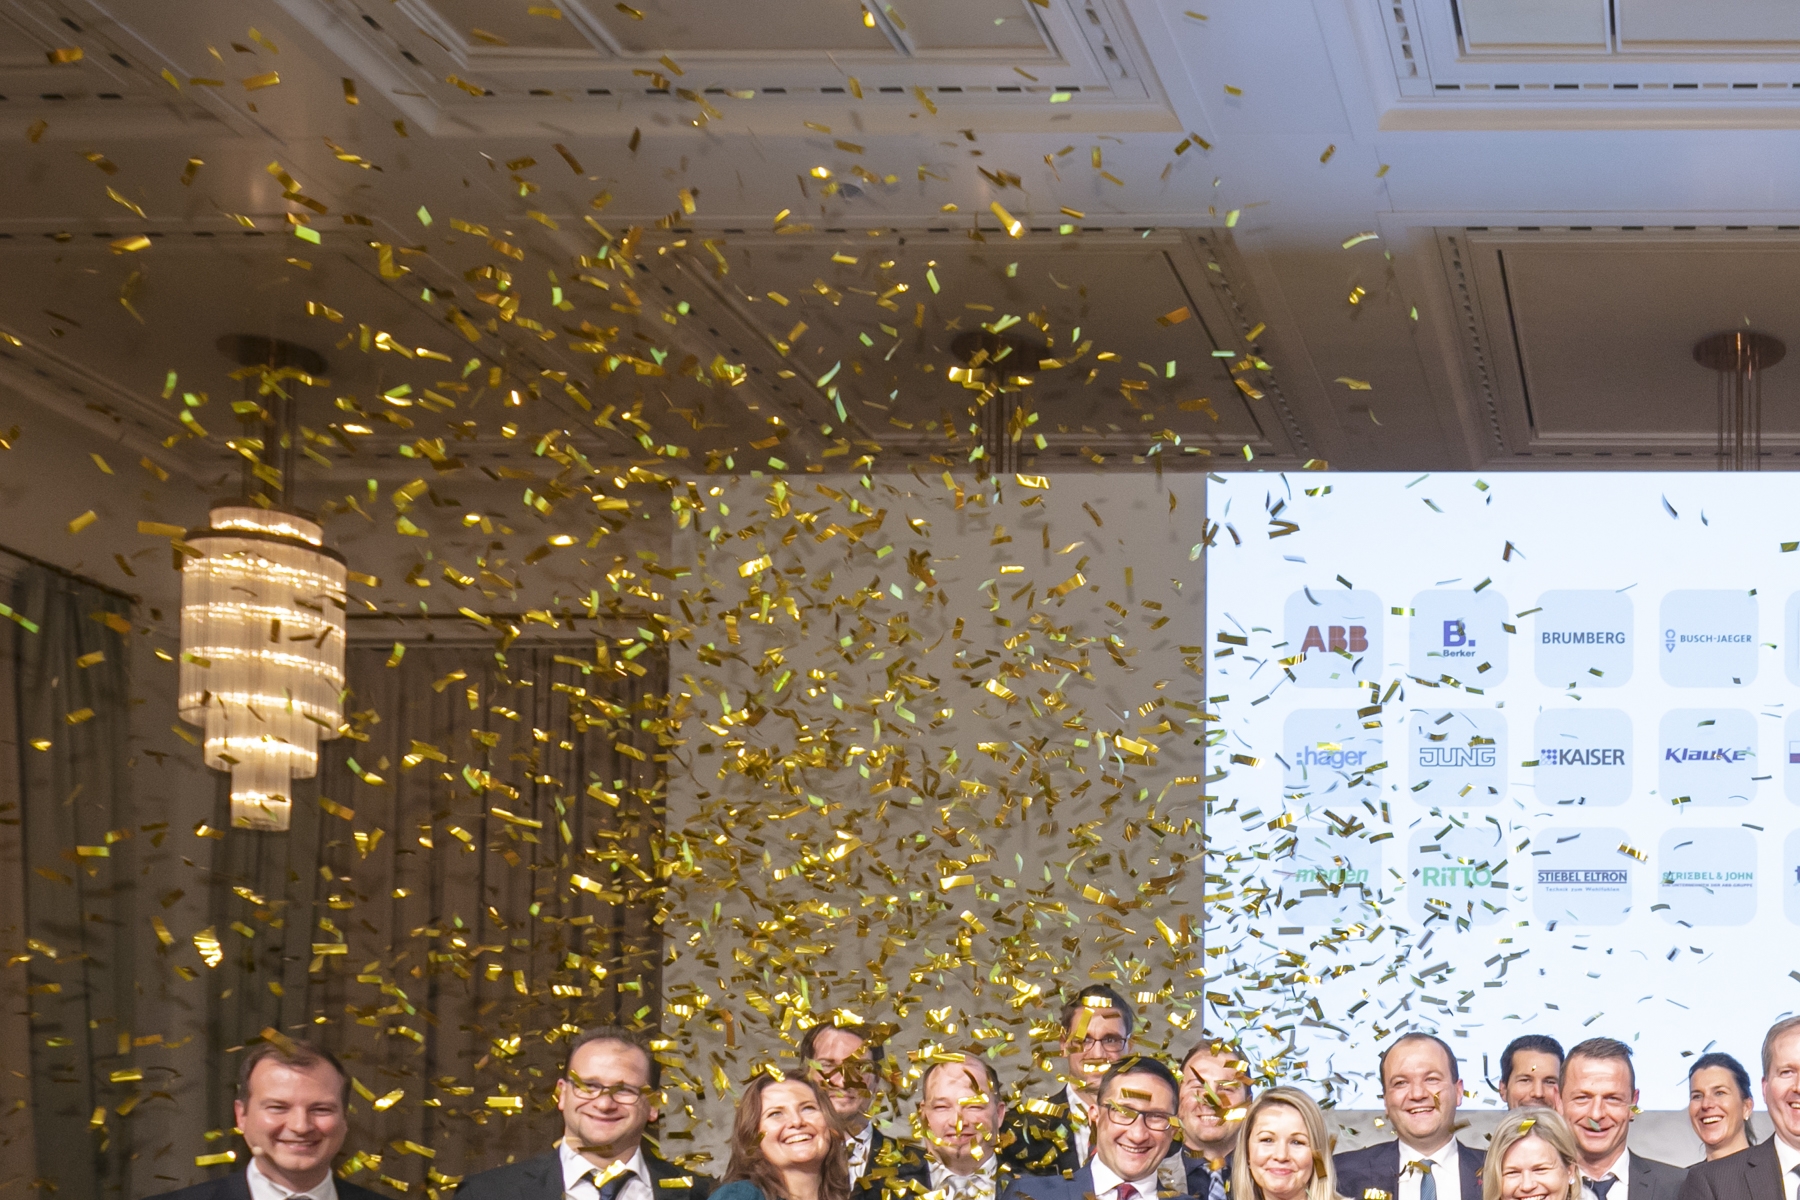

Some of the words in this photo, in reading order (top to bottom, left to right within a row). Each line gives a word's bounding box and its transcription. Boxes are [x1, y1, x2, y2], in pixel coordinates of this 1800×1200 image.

[1301, 625, 1369, 653] ABB
[1443, 620, 1476, 647] B.
[1541, 631, 1626, 645] BRUMBERG
[1680, 634, 1752, 643] BUSCH-JAEGER
[1443, 649, 1476, 657] Berker
[1419, 747, 1496, 767] JUNG
[1559, 748, 1626, 766] KAISER
[1537, 872, 1582, 882] STIEBEL
[1584, 872, 1628, 882] ELTRON
[1716, 871, 1723, 881] &
[1725, 871, 1754, 882] JOHN
